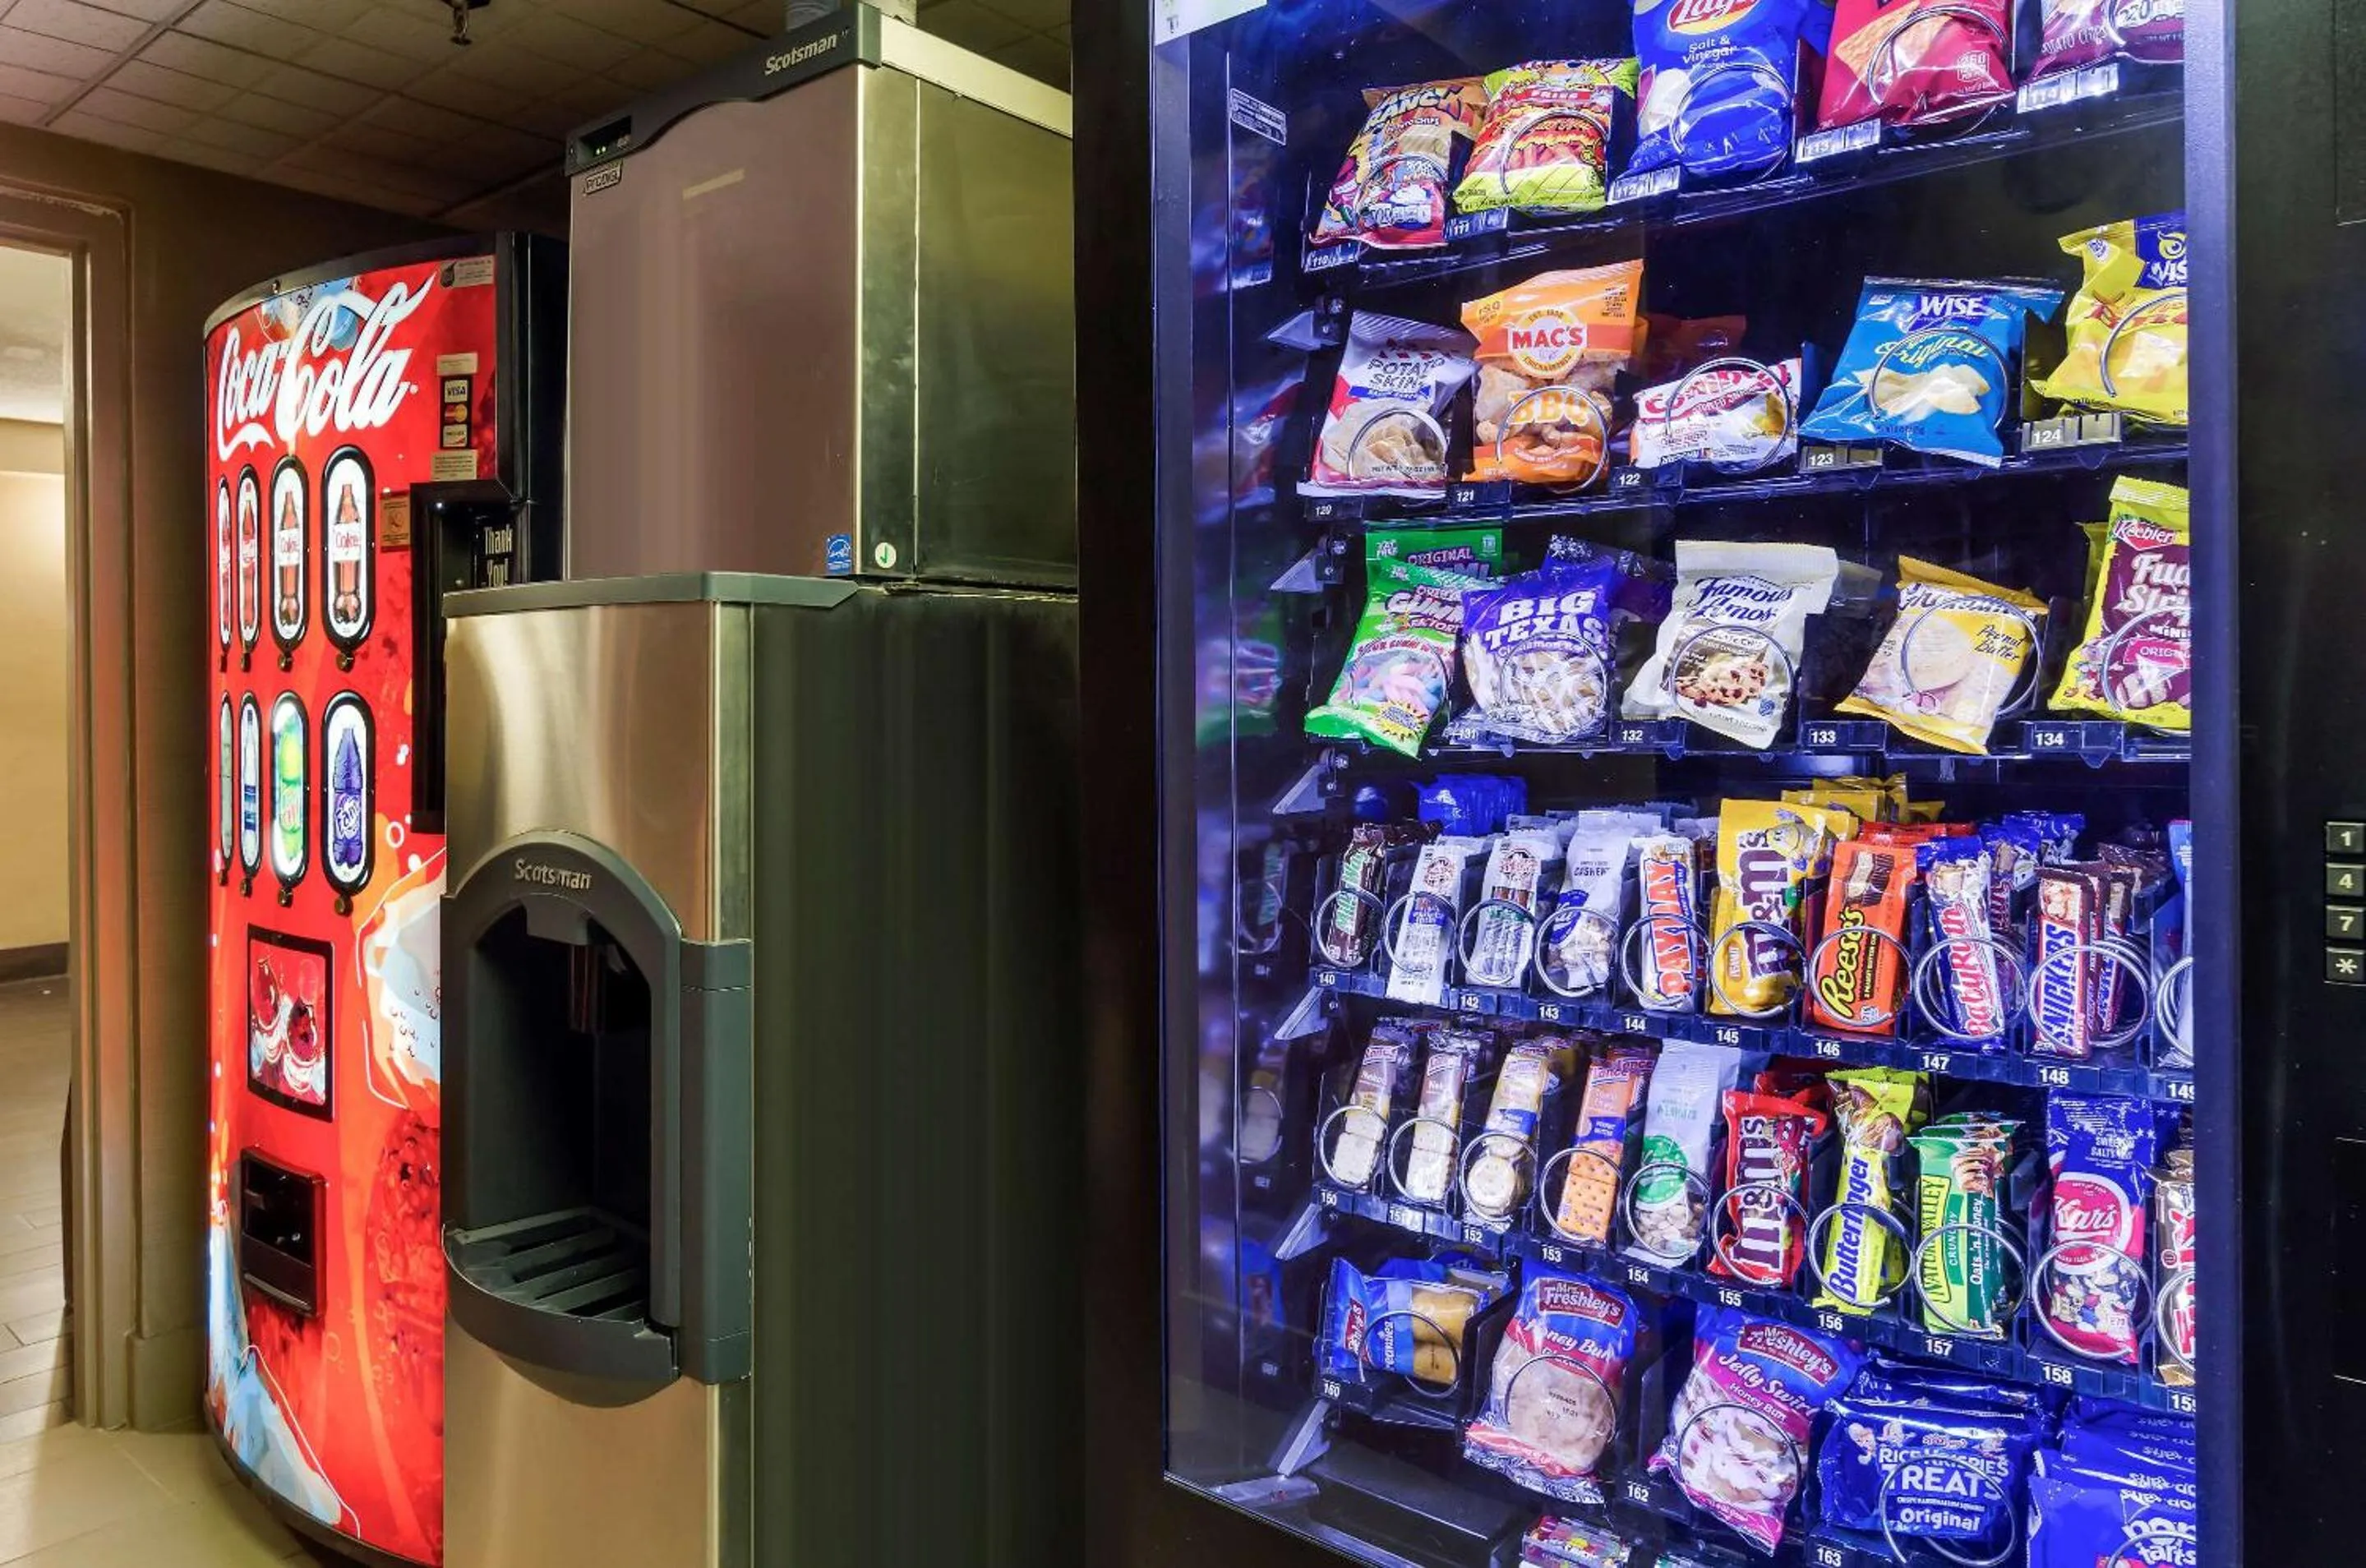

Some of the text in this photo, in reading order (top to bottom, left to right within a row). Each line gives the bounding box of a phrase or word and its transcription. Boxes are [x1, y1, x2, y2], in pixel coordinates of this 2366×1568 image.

[1689, 35, 1731, 53] Salt &
[764, 34, 837, 76] Scotsman
[2148, 259, 2187, 285] WIS
[1921, 294, 1984, 316] WISE
[1512, 325, 1584, 349] MAC'S
[218, 272, 438, 462] Coca-Cola
[2033, 428, 2061, 444] 124
[1810, 454, 1833, 466] 123
[1619, 473, 1640, 485] 122
[1456, 490, 1474, 502] 121
[483, 524, 514, 555] Thank
[2115, 520, 2175, 544] Keebler
[1408, 546, 1474, 565] ORIGINAL
[1695, 576, 1793, 606] Famous
[1498, 591, 1596, 625] BIG
[1694, 597, 1778, 622] Amos
[1485, 616, 1603, 649] TEXAS
[1976, 624, 2026, 648] Peanut
[2150, 624, 2190, 639] MINI
[1974, 639, 2019, 661] Butter
[1622, 730, 1643, 740] 132
[1811, 731, 1837, 743] 133
[2035, 733, 2064, 745] 134
[2341, 831, 2351, 846] 1
[514, 858, 592, 890] Scotsman
[2338, 874, 2354, 888] 4
[1644, 860, 1693, 996] PAYDAY
[2339, 915, 2354, 931] 7
[1820, 906, 1865, 1018] Reese's
[1319, 973, 1335, 985] 140
[2041, 923, 2078, 1050] SNICKERS
[1460, 995, 1478, 1007] 142
[1539, 1007, 1559, 1019] 143
[1625, 1018, 1645, 1031] 144
[1716, 1031, 1739, 1044] 145
[1815, 1043, 1840, 1056] 146
[1922, 1055, 1950, 1070] 147
[2040, 1069, 2069, 1085] 148
[1321, 1193, 1337, 1205] 150
[2055, 1196, 2116, 1230] Kar's
[1464, 1231, 1483, 1242] 152
[1829, 1157, 1871, 1300] Butterfinger
[1543, 1247, 1561, 1261] 153
[1921, 1235, 1944, 1296] NATUR
[1970, 1257, 1982, 1285] Oats
[1628, 1271, 1649, 1283] 154
[1544, 1286, 1621, 1317] Freshley's
[1719, 1291, 1741, 1305] 155
[1819, 1316, 1843, 1330] 156
[1747, 1330, 1833, 1377] Freshley's
[1926, 1340, 1953, 1355] 157
[1718, 1353, 1764, 1388] Jelly
[2042, 1367, 2073, 1384] 158
[1324, 1382, 1340, 1396] 160
[1883, 1464, 2003, 1500] TREATS
[1628, 1485, 1649, 1501] 162
[1900, 1507, 1981, 1531] Original
[1818, 1547, 1842, 1565] 163
